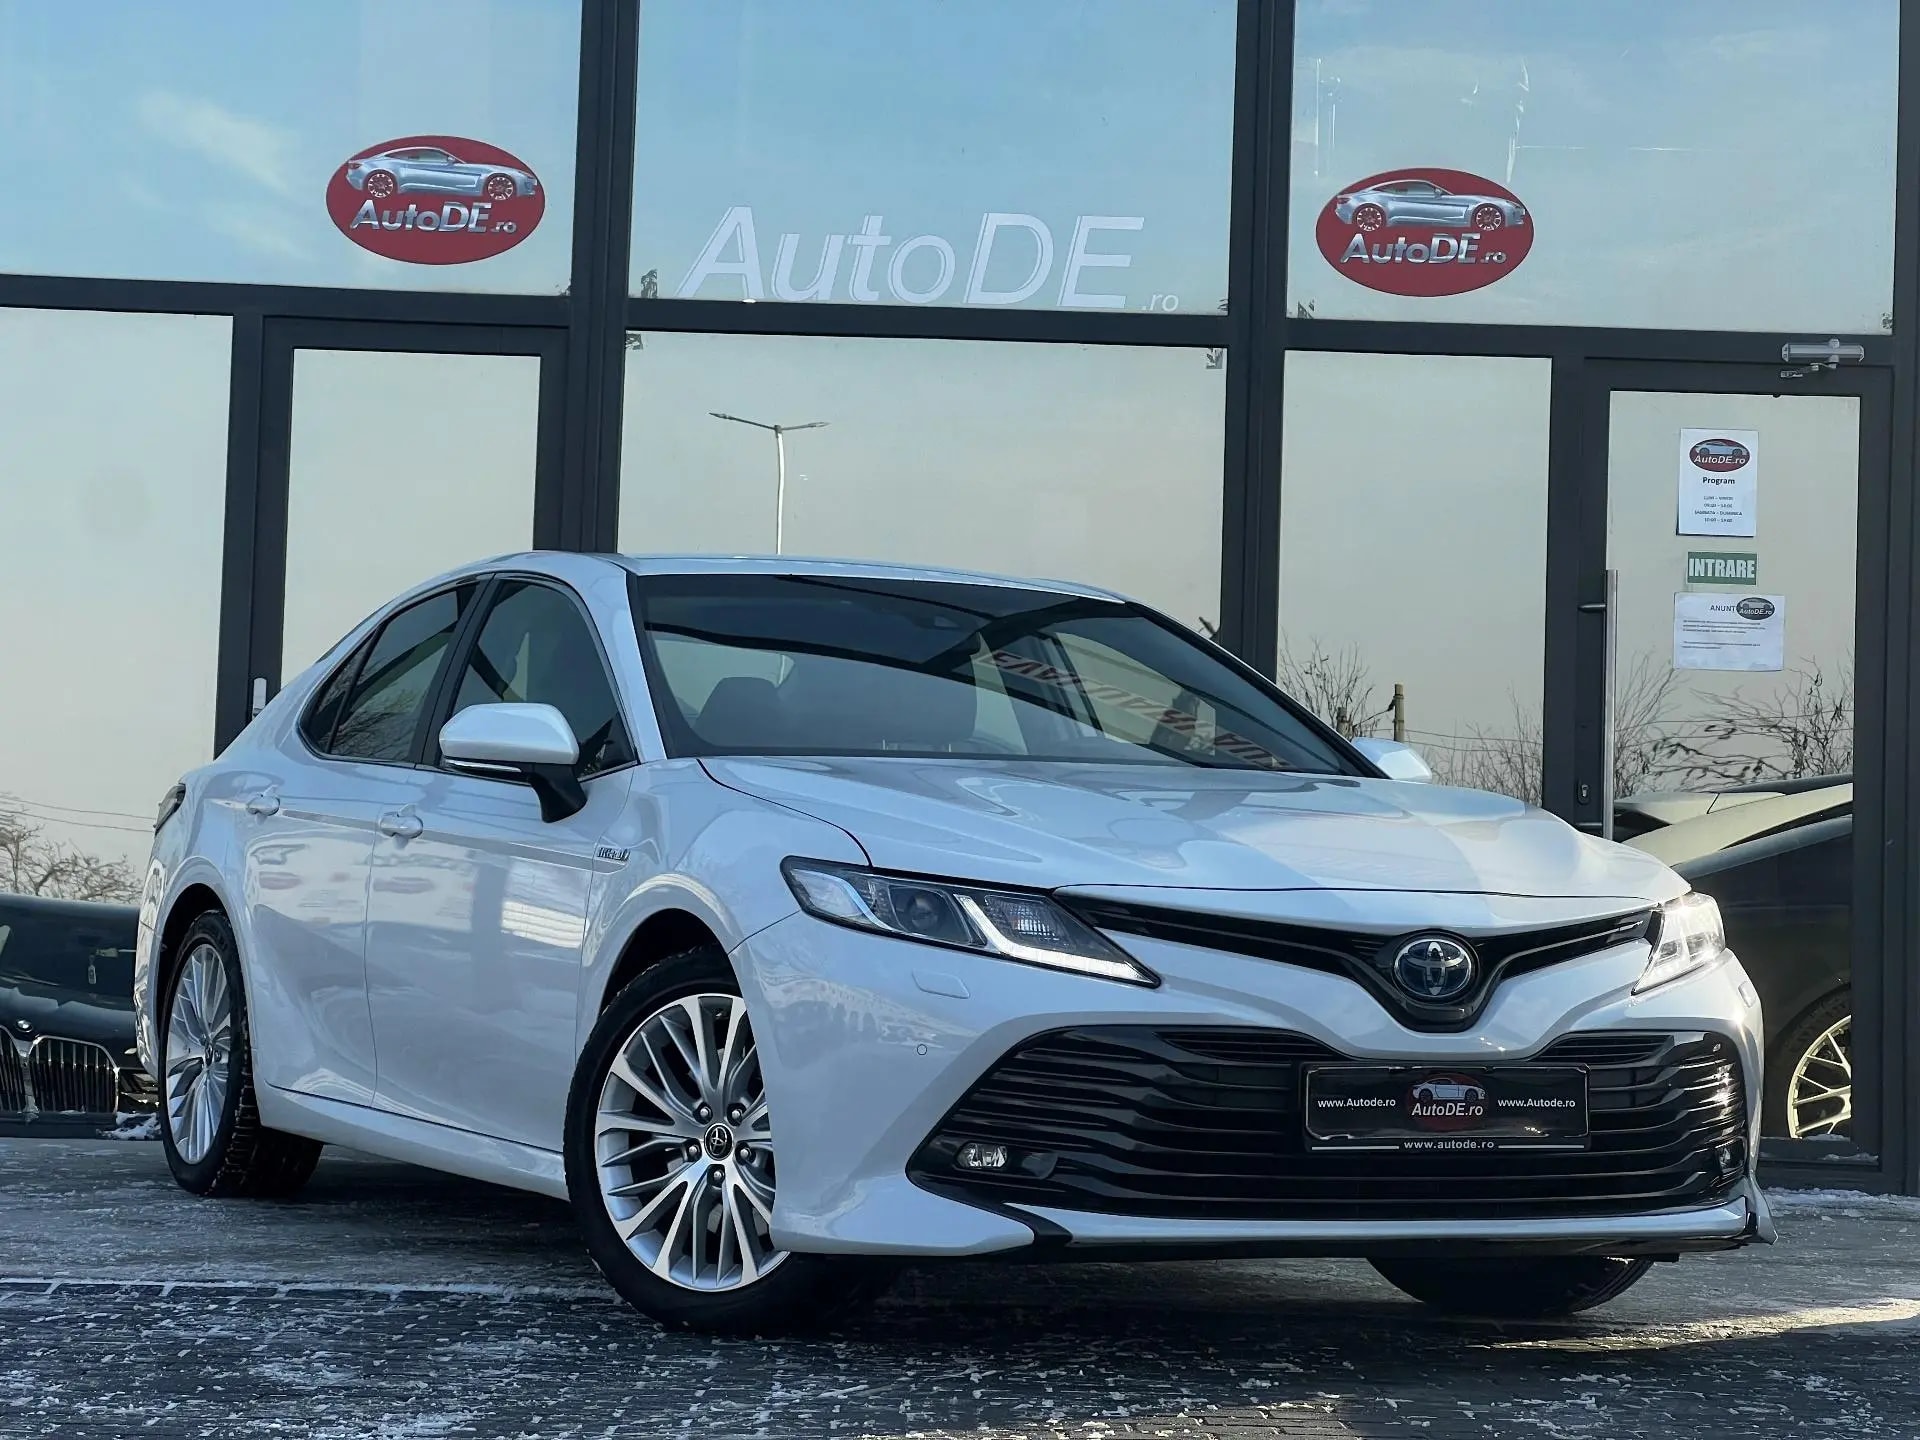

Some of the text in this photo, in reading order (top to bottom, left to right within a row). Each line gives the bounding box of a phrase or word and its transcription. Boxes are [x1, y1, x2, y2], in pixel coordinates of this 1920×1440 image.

[1702, 476, 1736, 486] Program
[1688, 558, 1755, 579] INTRARE
[1710, 604, 1736, 612] ANUNT
[1317, 1097, 1396, 1108] www.Autode.ro
[1497, 1097, 1576, 1108] www.Autode.ro
[1411, 1102, 1484, 1117] AutoDE.ro
[1403, 1139, 1495, 1149] www.autode.ro
